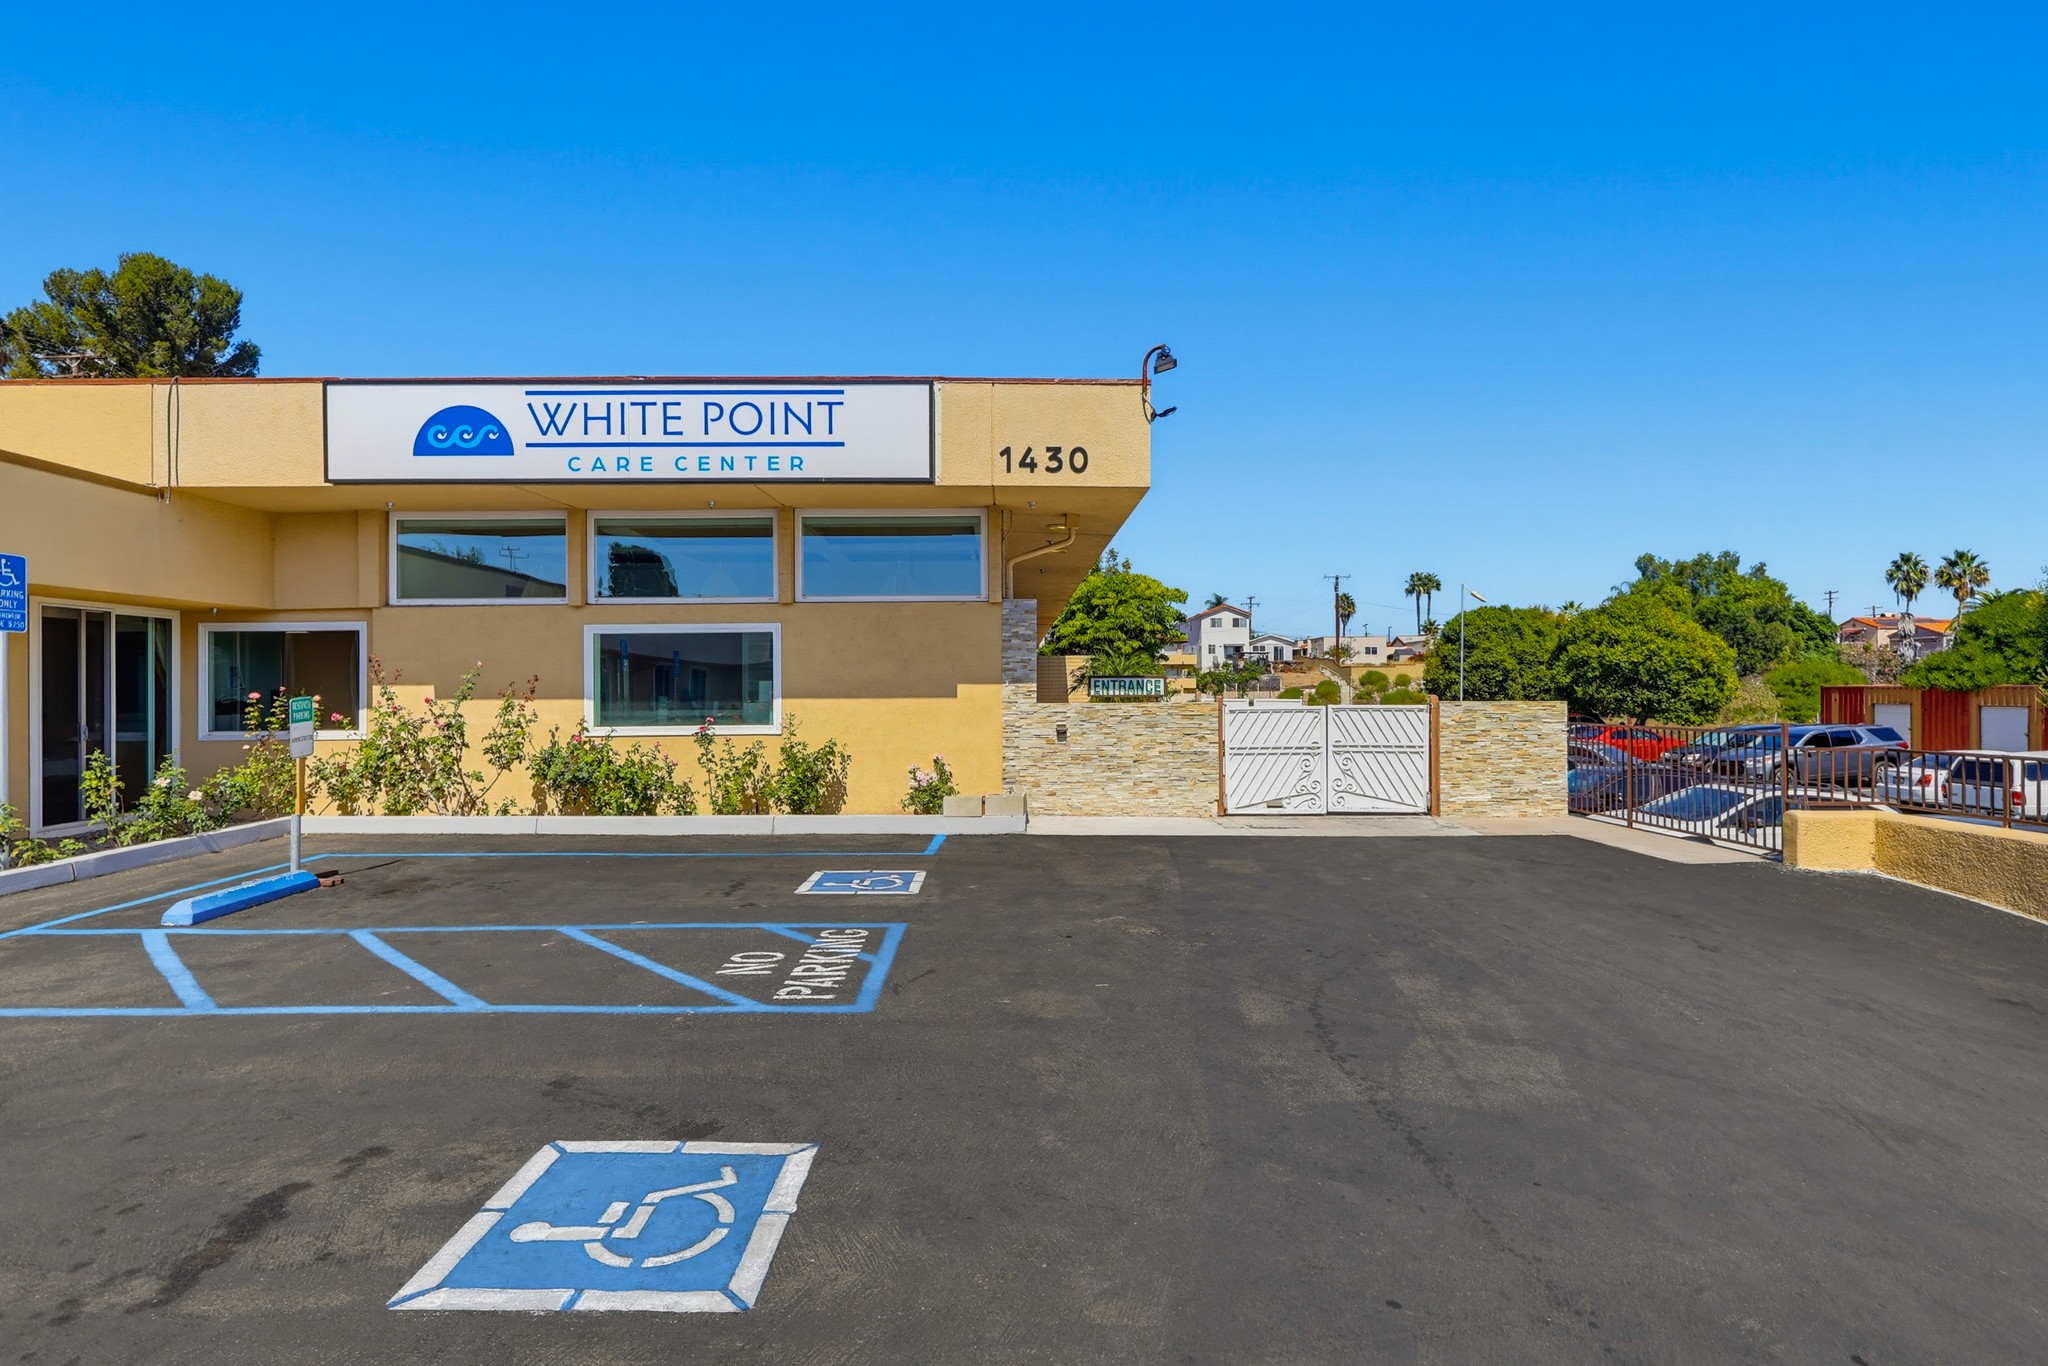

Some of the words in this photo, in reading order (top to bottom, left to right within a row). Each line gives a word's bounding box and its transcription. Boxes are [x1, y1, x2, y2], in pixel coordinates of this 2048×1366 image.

[526, 401, 684, 436] WHITE
[704, 401, 844, 436] POINT
[567, 456, 653, 473] CARE
[674, 456, 805, 473] CENTER
[999, 446, 1089, 474] 1430
[0, 589, 24, 600] RKING
[1094, 679, 1161, 695] ENTRANCE
[716, 952, 785, 974] NO
[773, 928, 869, 1000] PARKING
